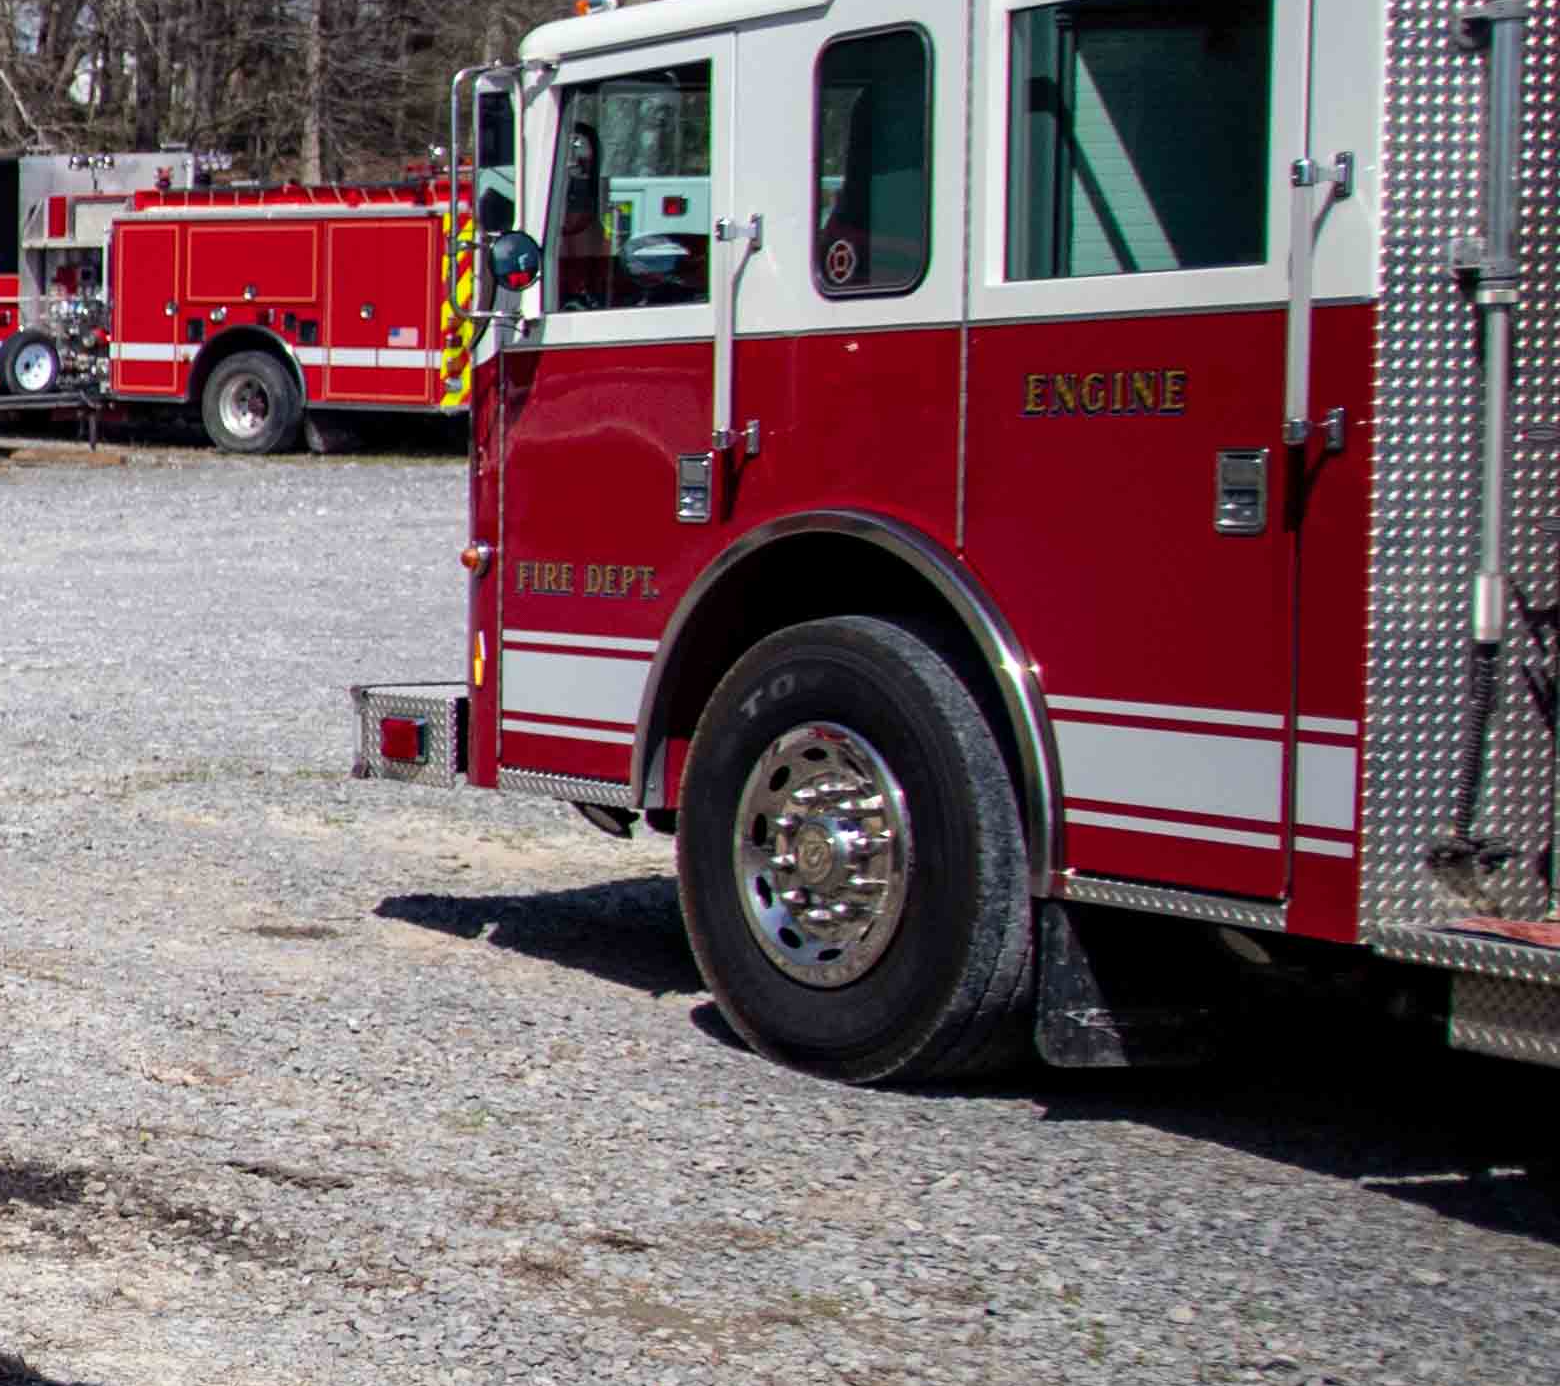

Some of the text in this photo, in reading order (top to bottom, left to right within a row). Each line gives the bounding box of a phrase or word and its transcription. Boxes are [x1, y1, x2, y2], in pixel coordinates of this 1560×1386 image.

[1021, 370, 1188, 417] ENGINE
[516, 562, 660, 598] FIRE DEPT.
